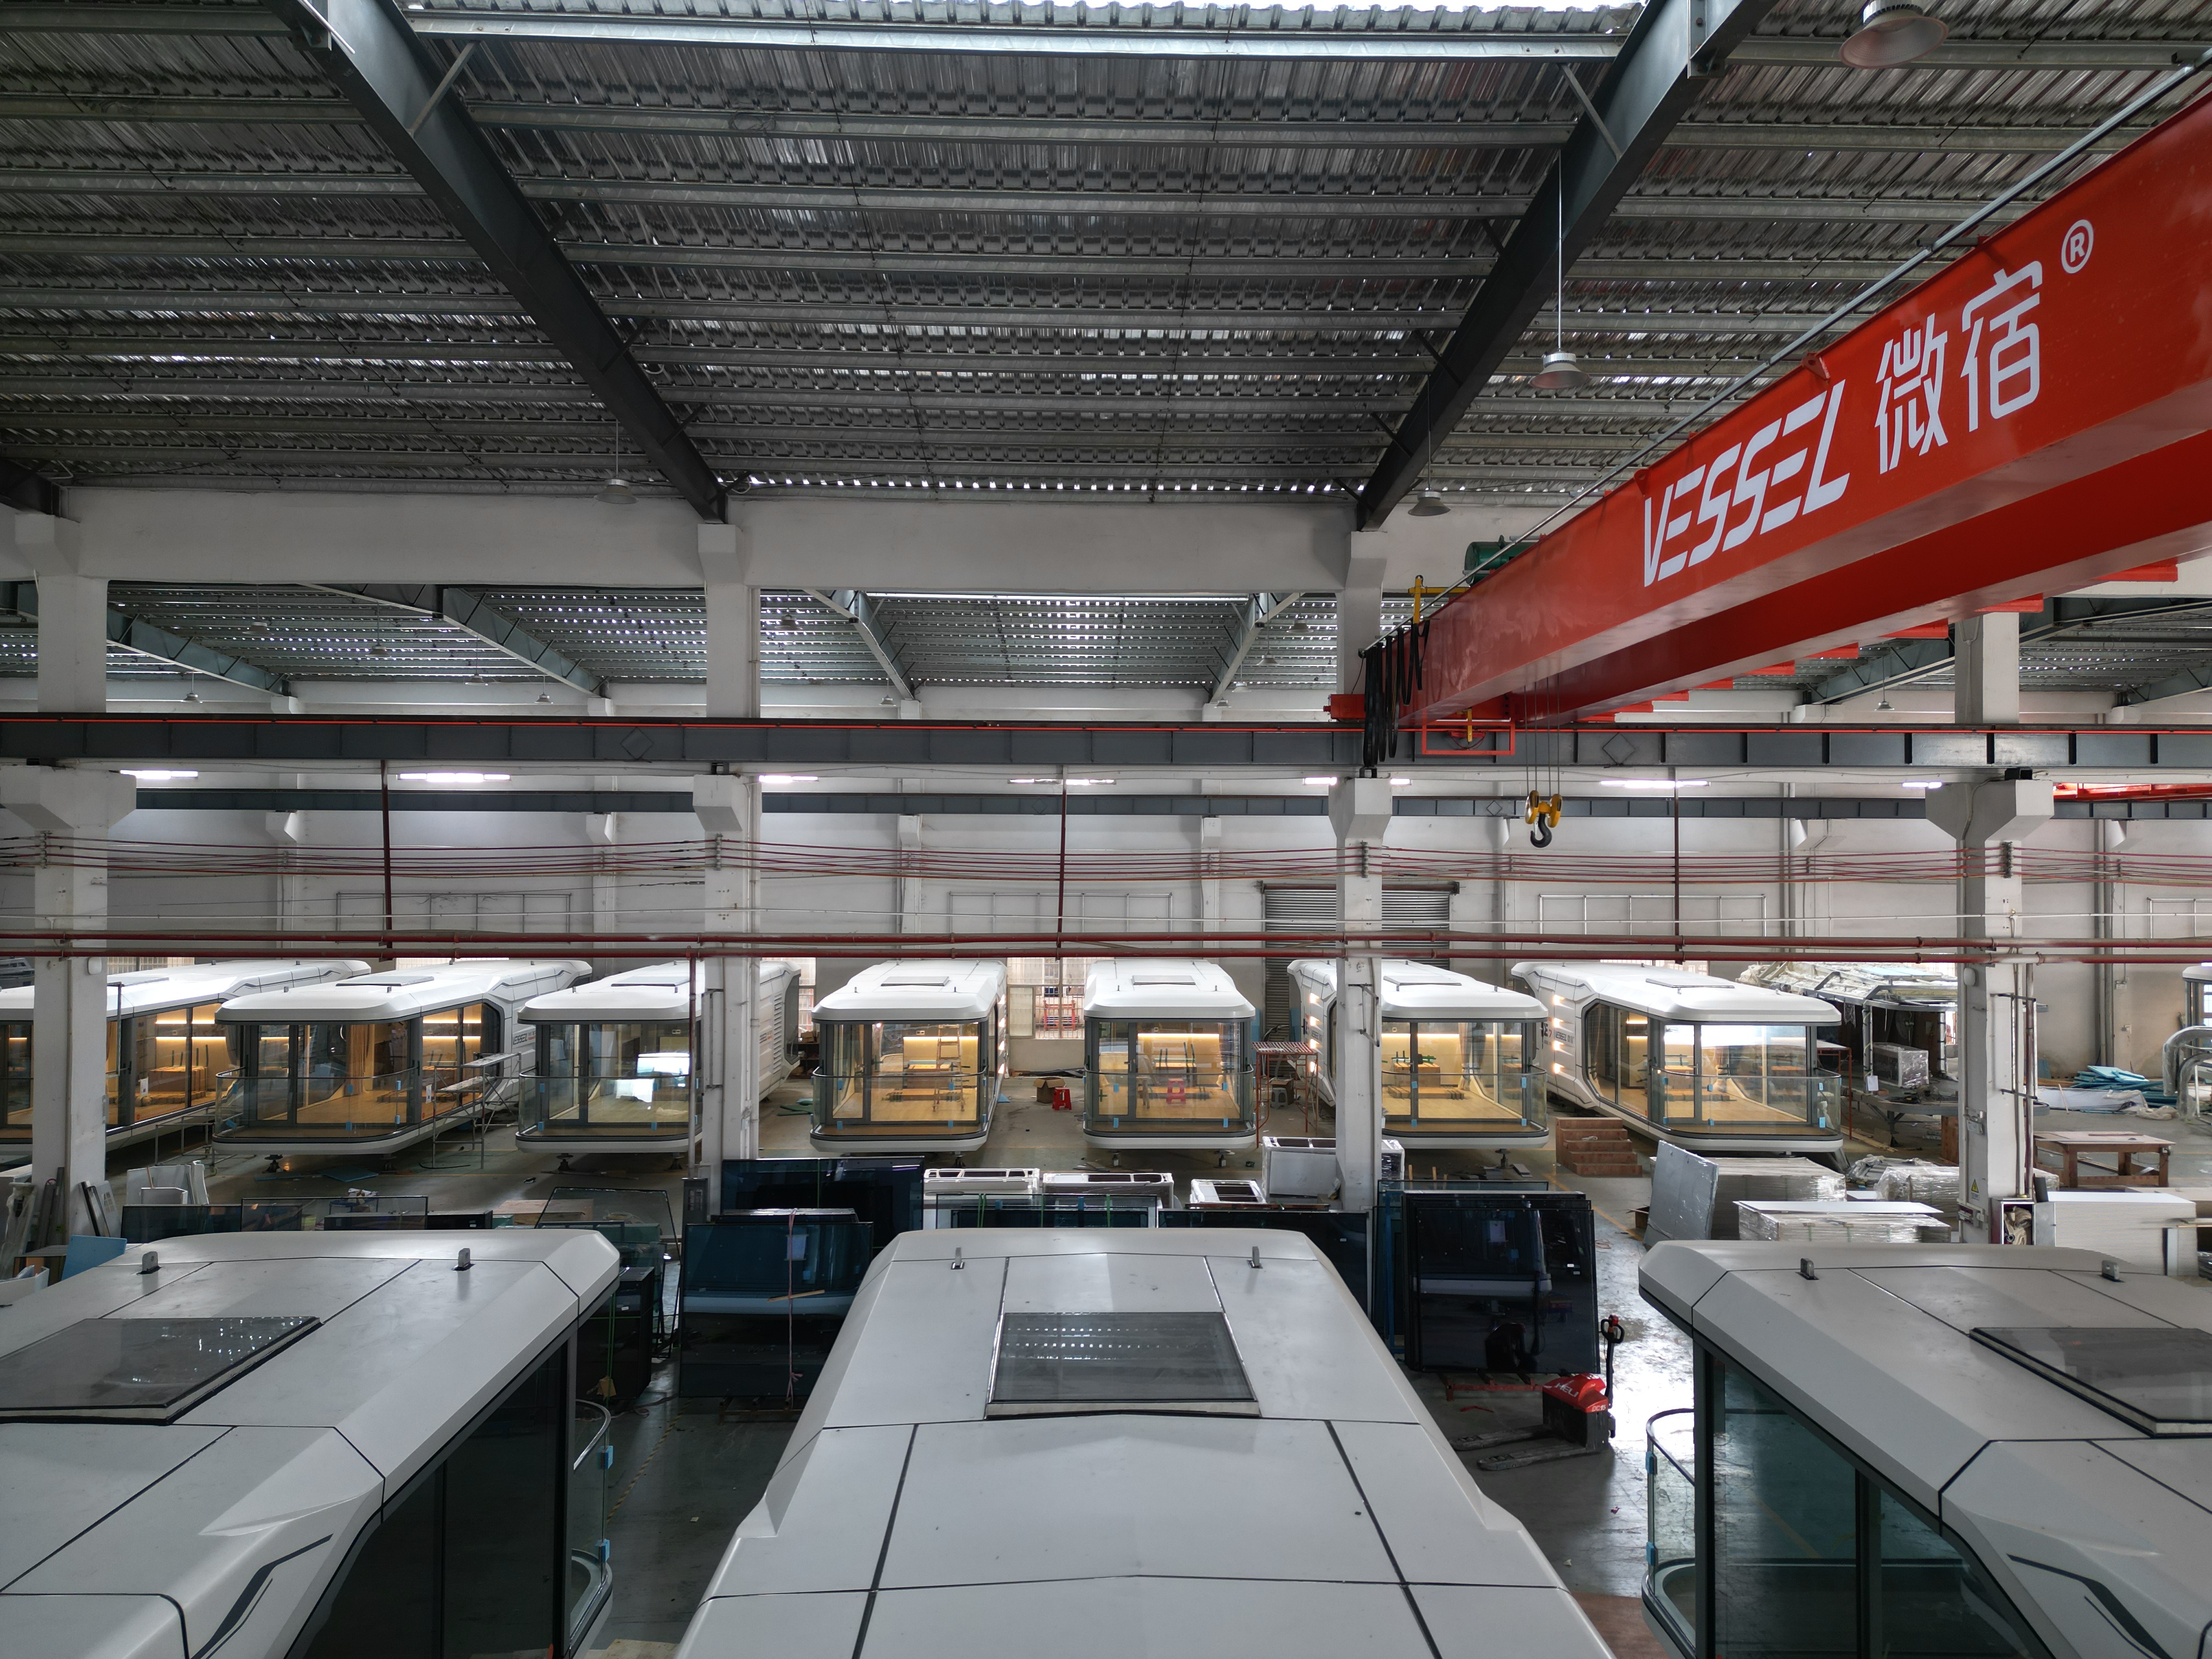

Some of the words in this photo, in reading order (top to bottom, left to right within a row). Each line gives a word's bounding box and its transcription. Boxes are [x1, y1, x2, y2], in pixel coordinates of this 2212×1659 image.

[1643, 379, 1850, 588] VESSEL
[1874, 259, 2043, 475] 微宿
[1555, 1381, 1579, 1398] HELI
